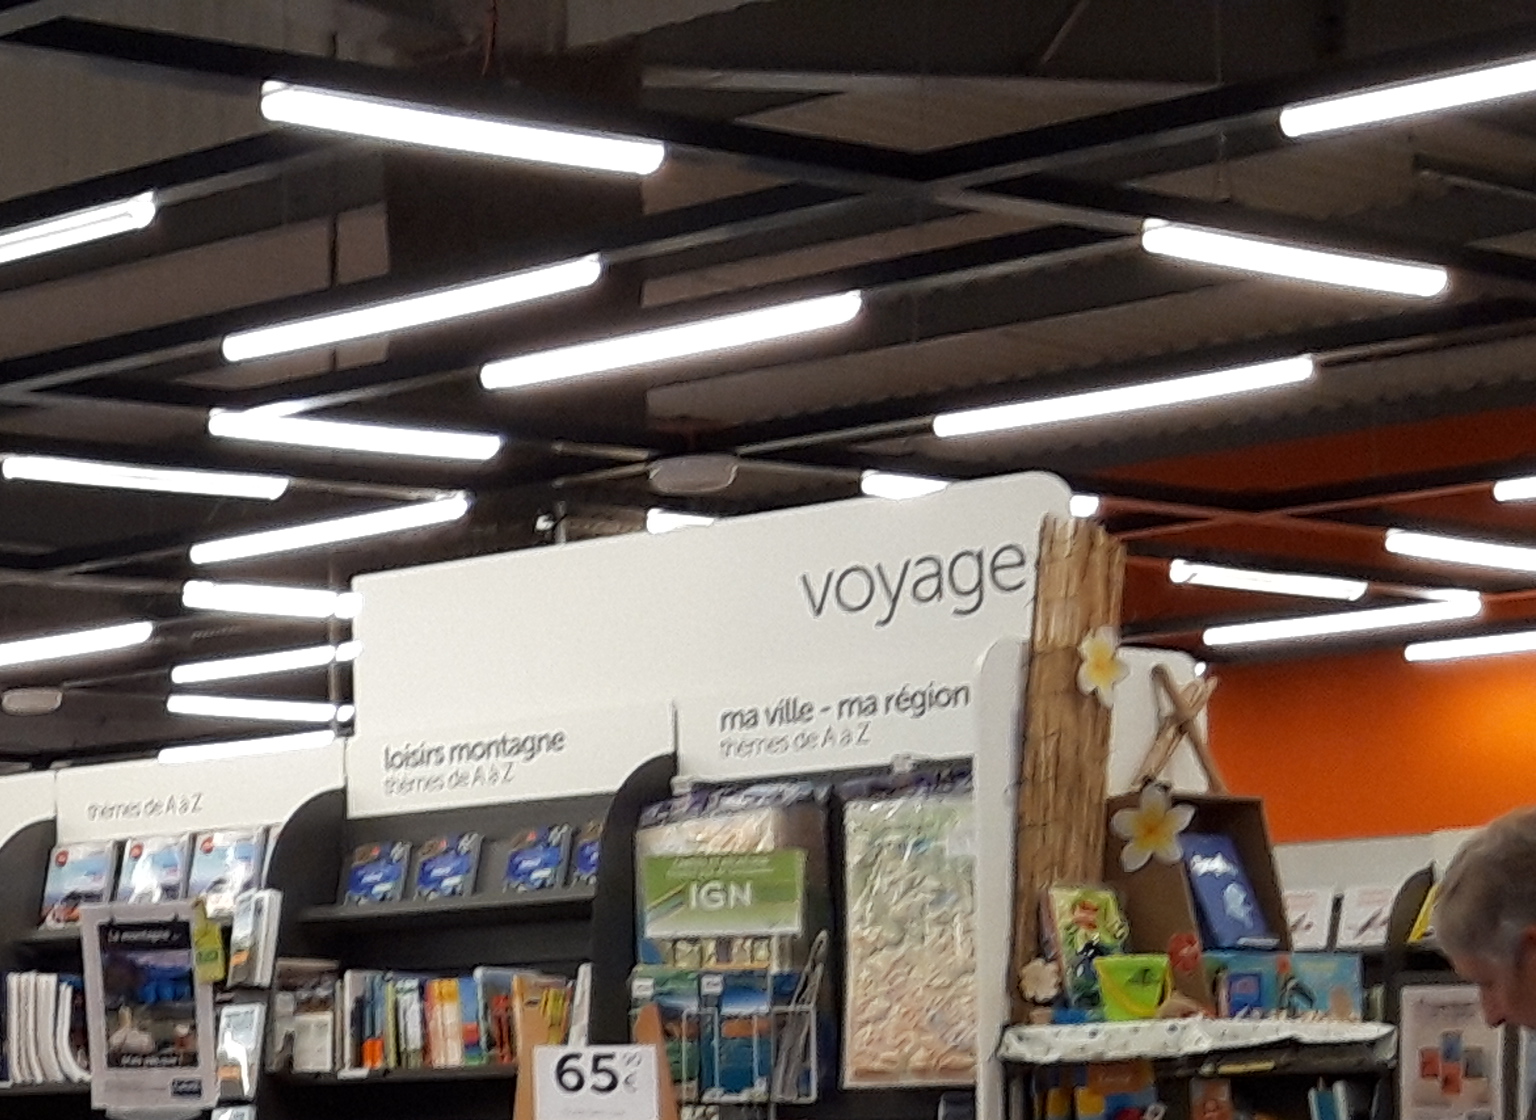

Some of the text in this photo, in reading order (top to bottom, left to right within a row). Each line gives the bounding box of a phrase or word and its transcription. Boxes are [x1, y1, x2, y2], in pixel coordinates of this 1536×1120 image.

[800, 542, 1027, 627] voyage
[719, 705, 759, 731] ma
[765, 697, 814, 728] ville
[839, 696, 878, 719] ma
[884, 681, 970, 725] région
[384, 728, 565, 771] loisirs montagne
[689, 881, 753, 910] IGN
[555, 1053, 619, 1093] 65
